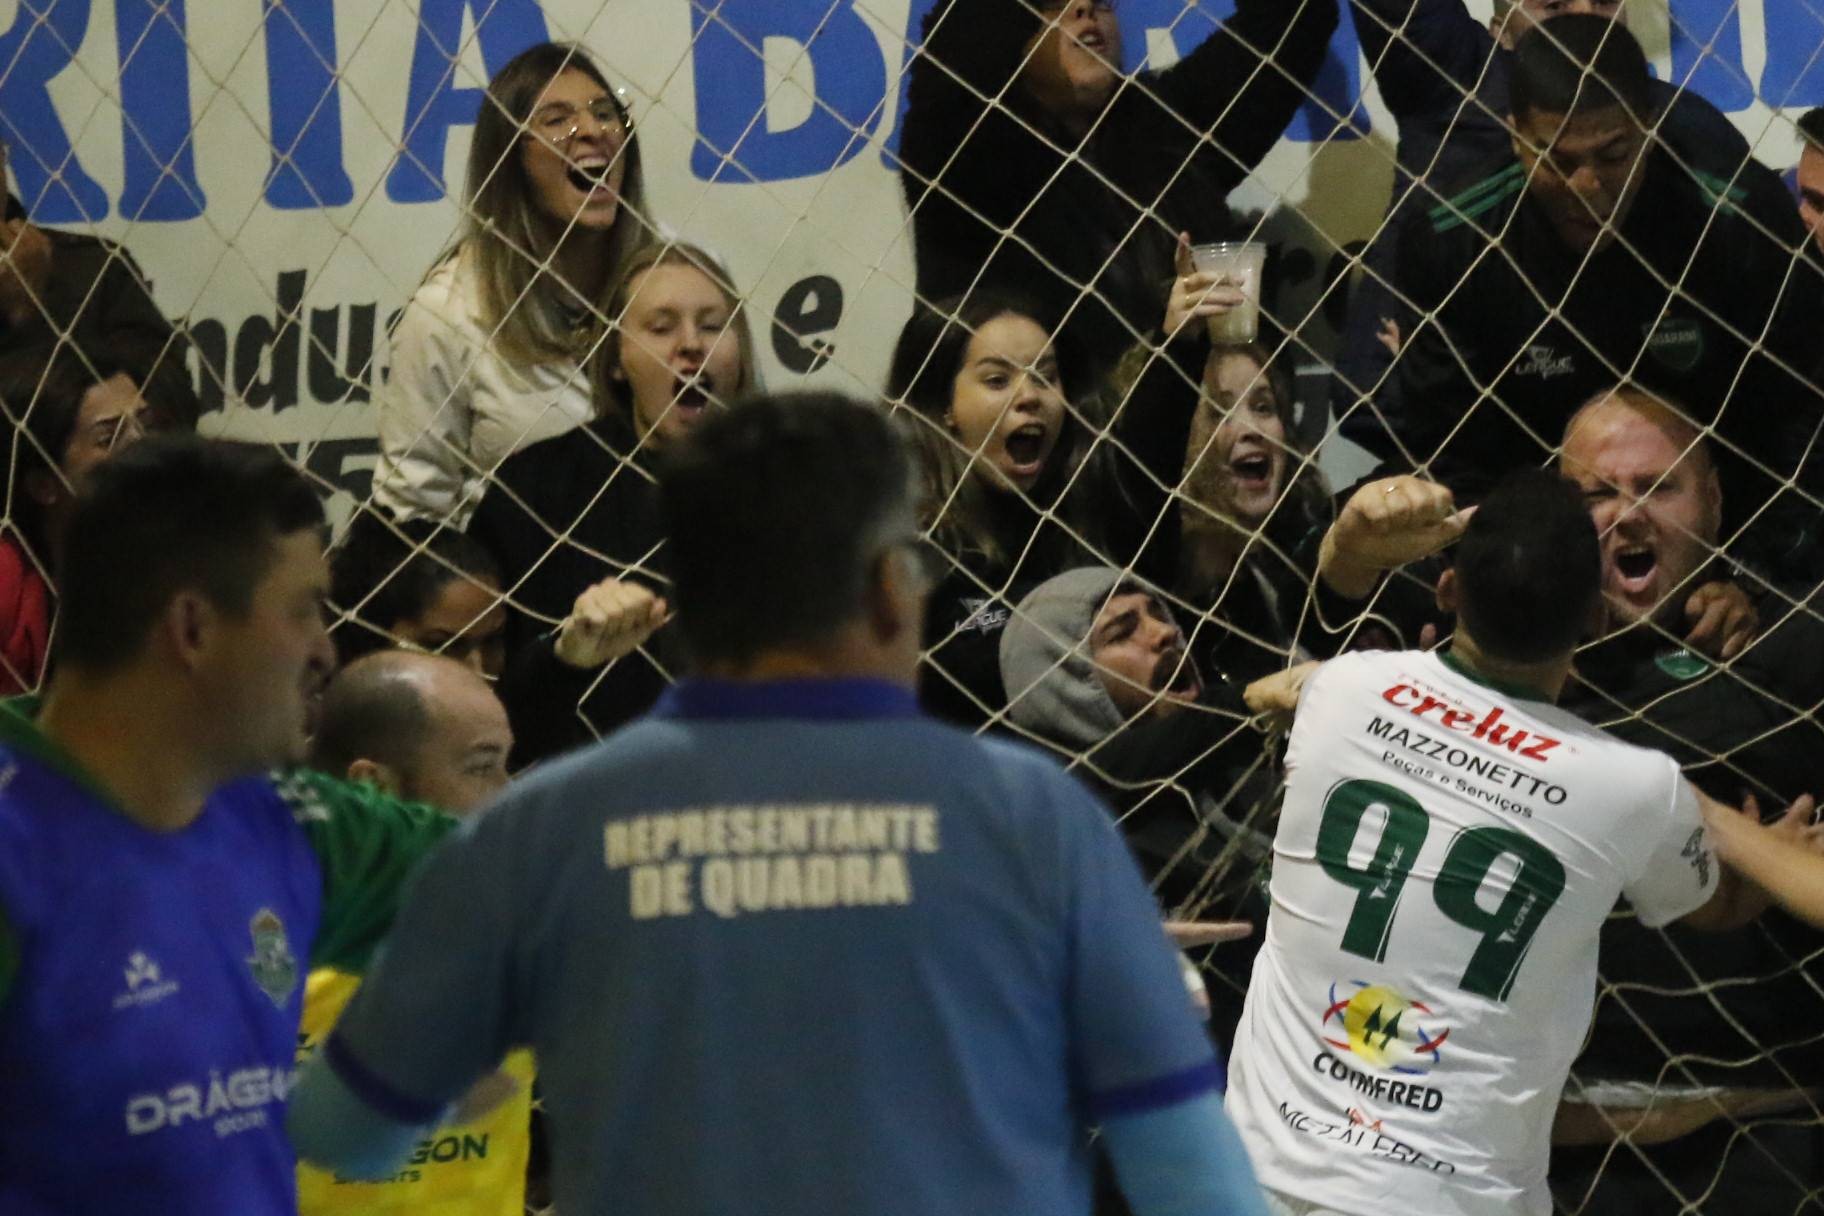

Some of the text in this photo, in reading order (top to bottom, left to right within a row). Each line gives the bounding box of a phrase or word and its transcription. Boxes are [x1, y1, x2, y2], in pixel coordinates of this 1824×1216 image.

[1381, 683, 1562, 763] creluz
[1366, 716, 1569, 806] MAZZONETTO
[1454, 777, 1533, 820] Serviços
[604, 803, 938, 869] REPRESENTANTE
[630, 852, 911, 920] DE QUADRA
[1314, 777, 1567, 1004] 99
